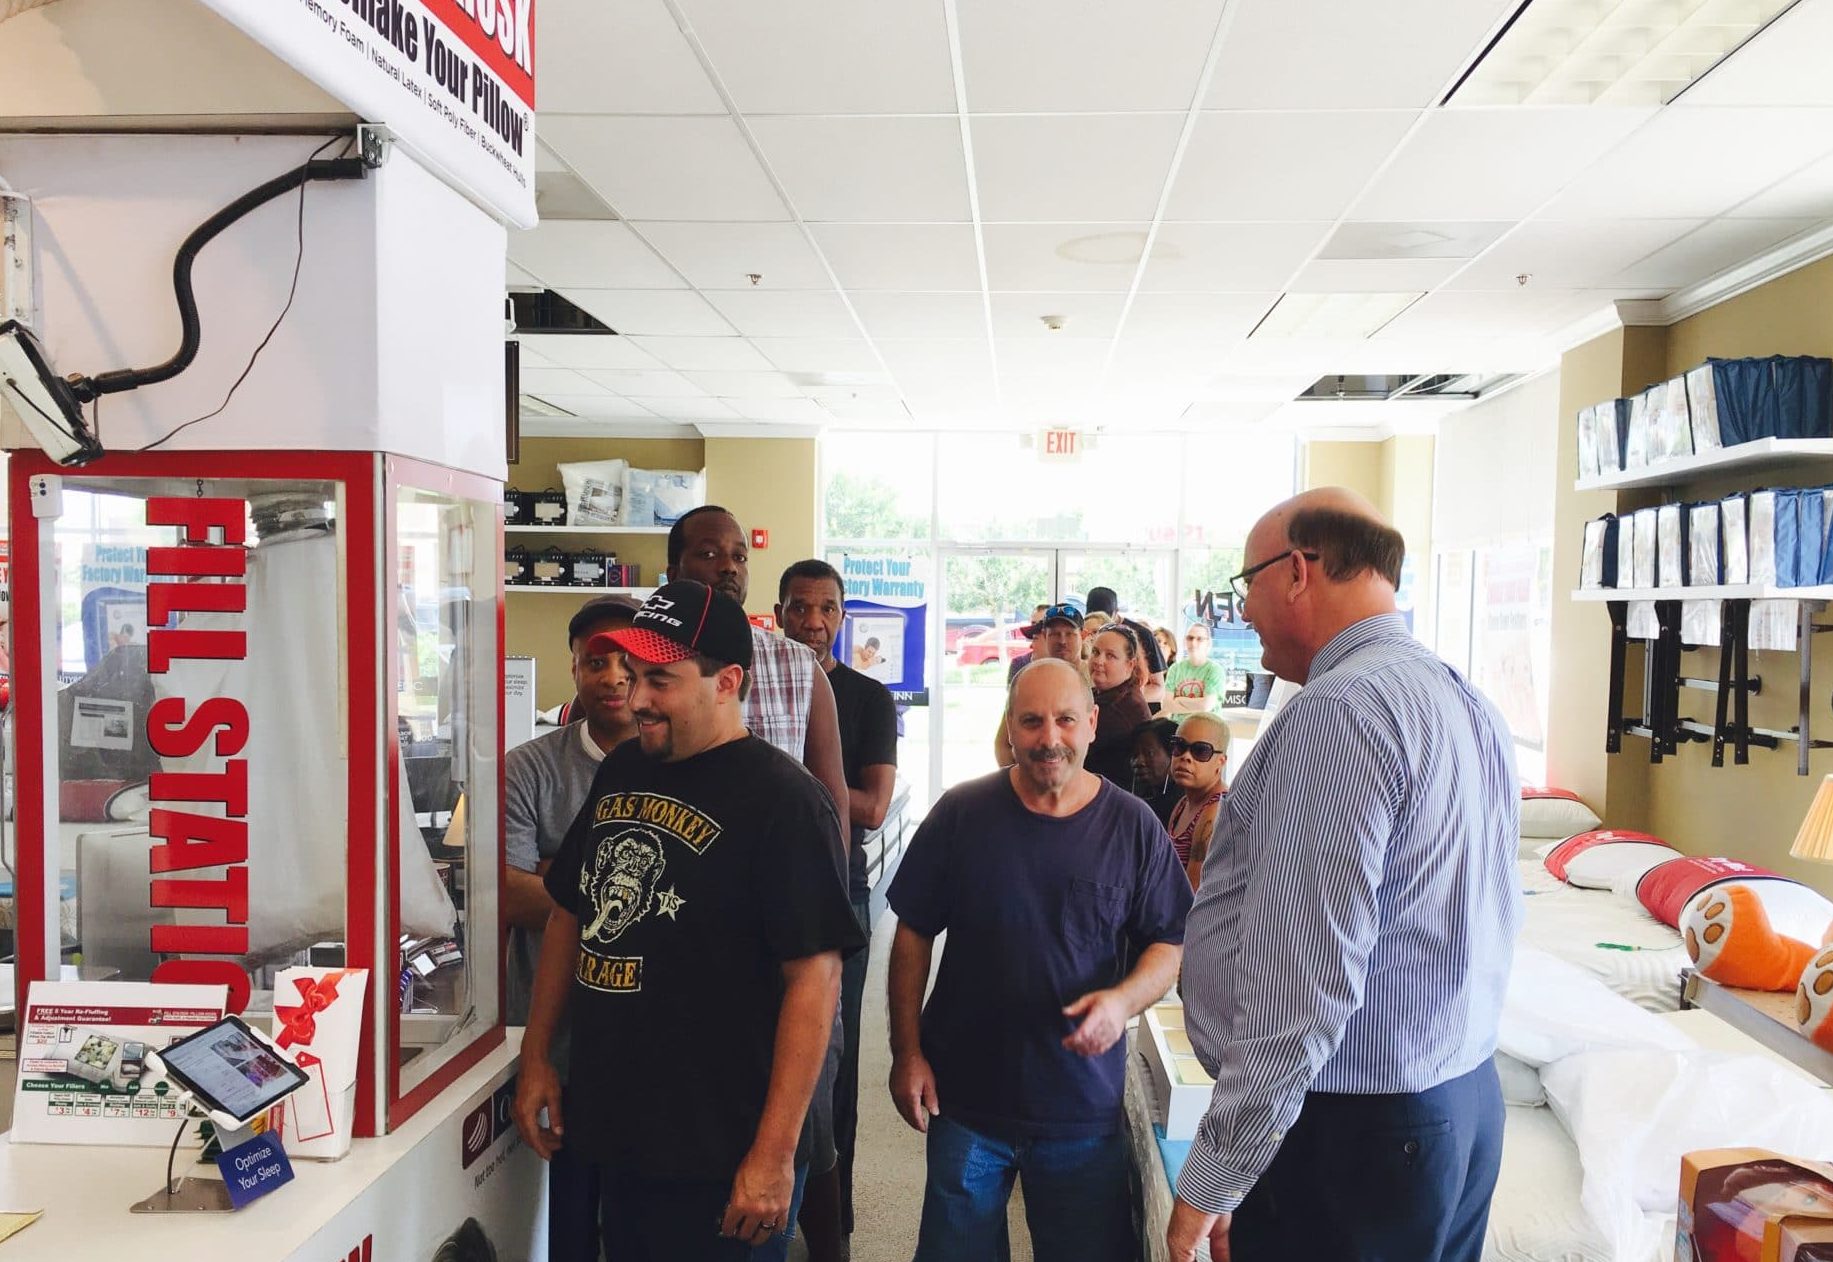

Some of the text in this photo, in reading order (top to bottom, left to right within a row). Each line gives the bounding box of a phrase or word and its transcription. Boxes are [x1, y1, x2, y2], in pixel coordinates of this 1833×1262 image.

[423, 15, 468, 104] Your
[340, 21, 365, 54] Foam
[372, 47, 400, 81] Natural
[402, 72, 422, 99] Latex
[428, 93, 442, 115] Soft
[444, 106, 458, 129] Poly
[460, 118, 477, 140] Fiber
[481, 135, 512, 174] Buckwheat
[1047, 432, 1076, 454] EXIT
[96, 545, 134, 563] Protect
[83, 565, 122, 583] Factory
[843, 558, 911, 577] Protect Your
[147, 497, 247, 674] FILL
[844, 578, 924, 598] ctory Warranty
[596, 796, 717, 845] GAS MONKEY
[147, 697, 250, 1015] STATIO
[660, 893, 679, 911] TXS
[580, 950, 637, 987] RAGE
[235, 1147, 272, 1172] Optimize
[239, 1163, 281, 1190] Your Sleep
